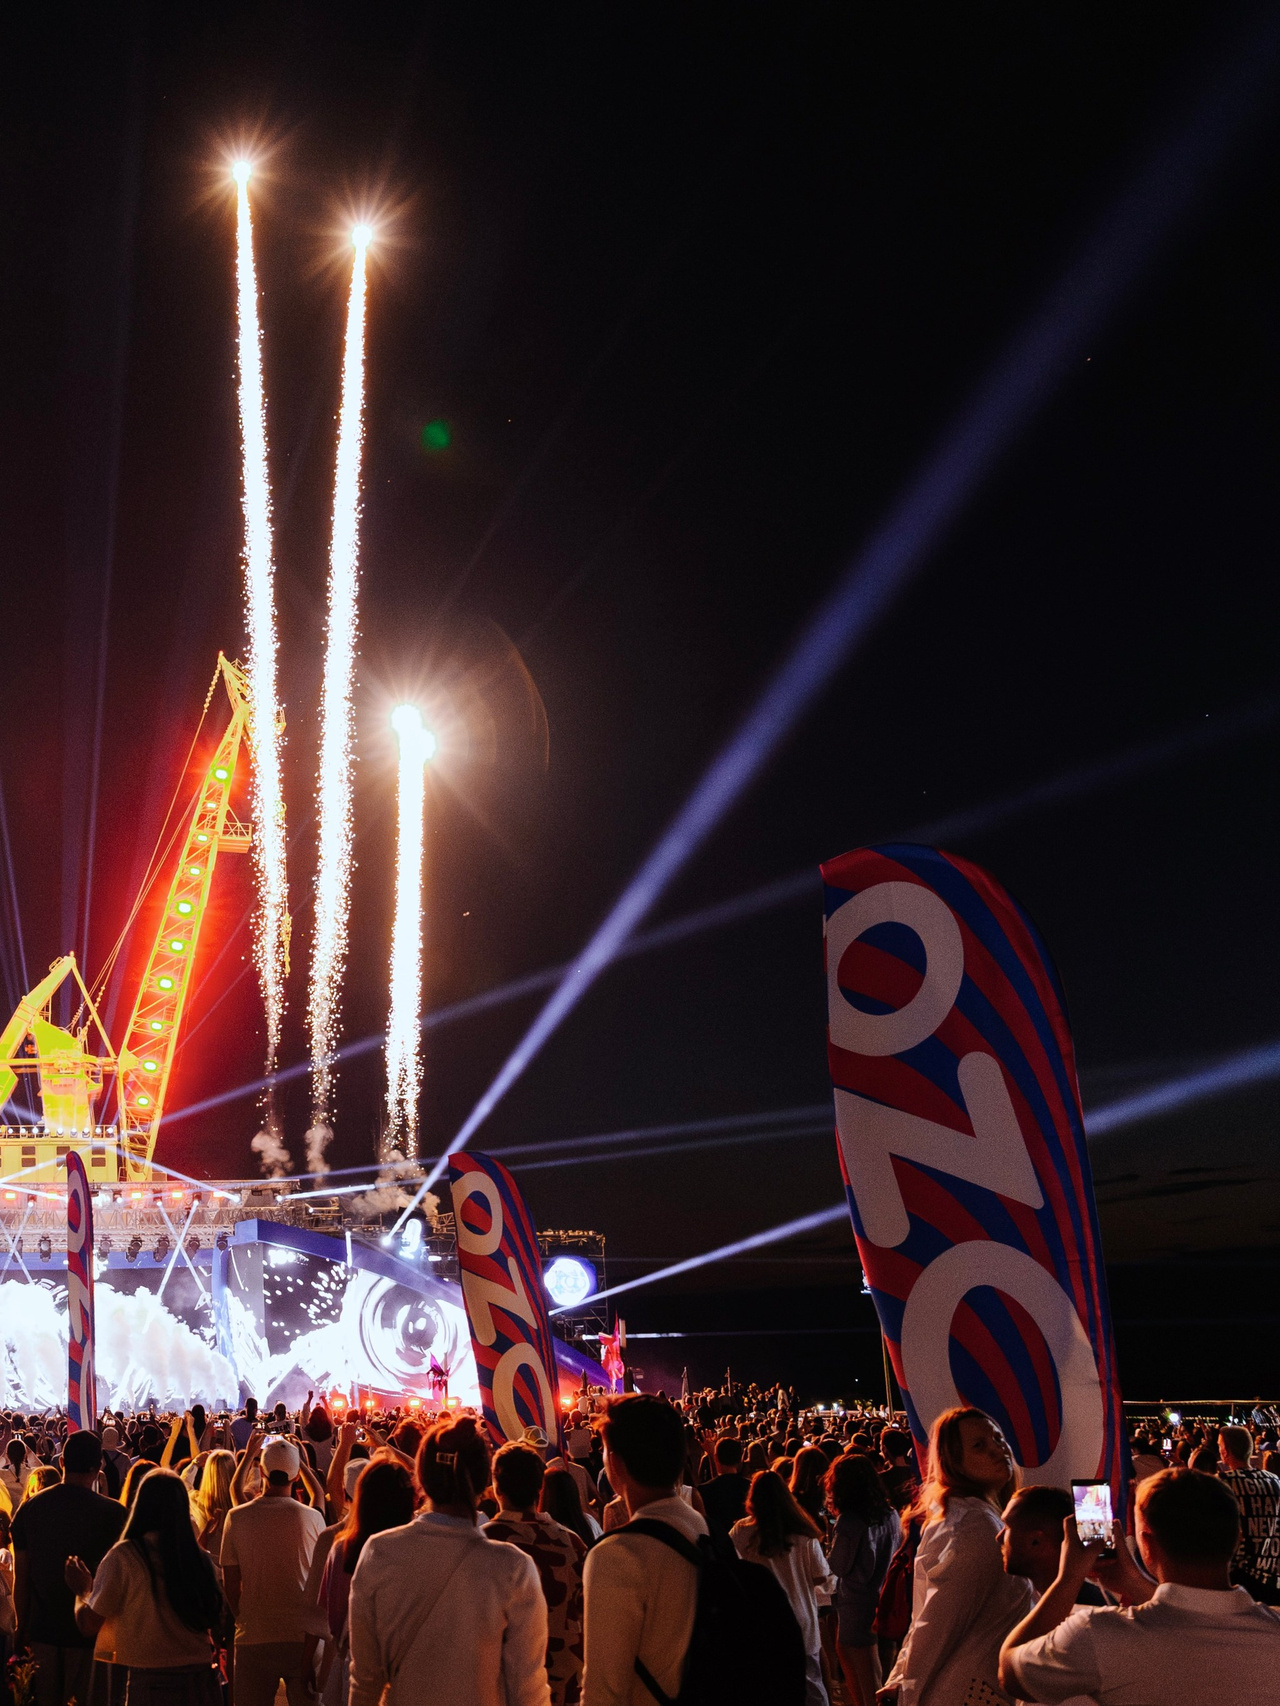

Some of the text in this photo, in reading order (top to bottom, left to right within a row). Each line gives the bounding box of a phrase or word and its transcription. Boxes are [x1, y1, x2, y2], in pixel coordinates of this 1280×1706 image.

[451, 1171, 558, 1446] OZO
[823, 881, 1104, 1493] OZO
[1248, 1517, 1280, 1536] NEVE
